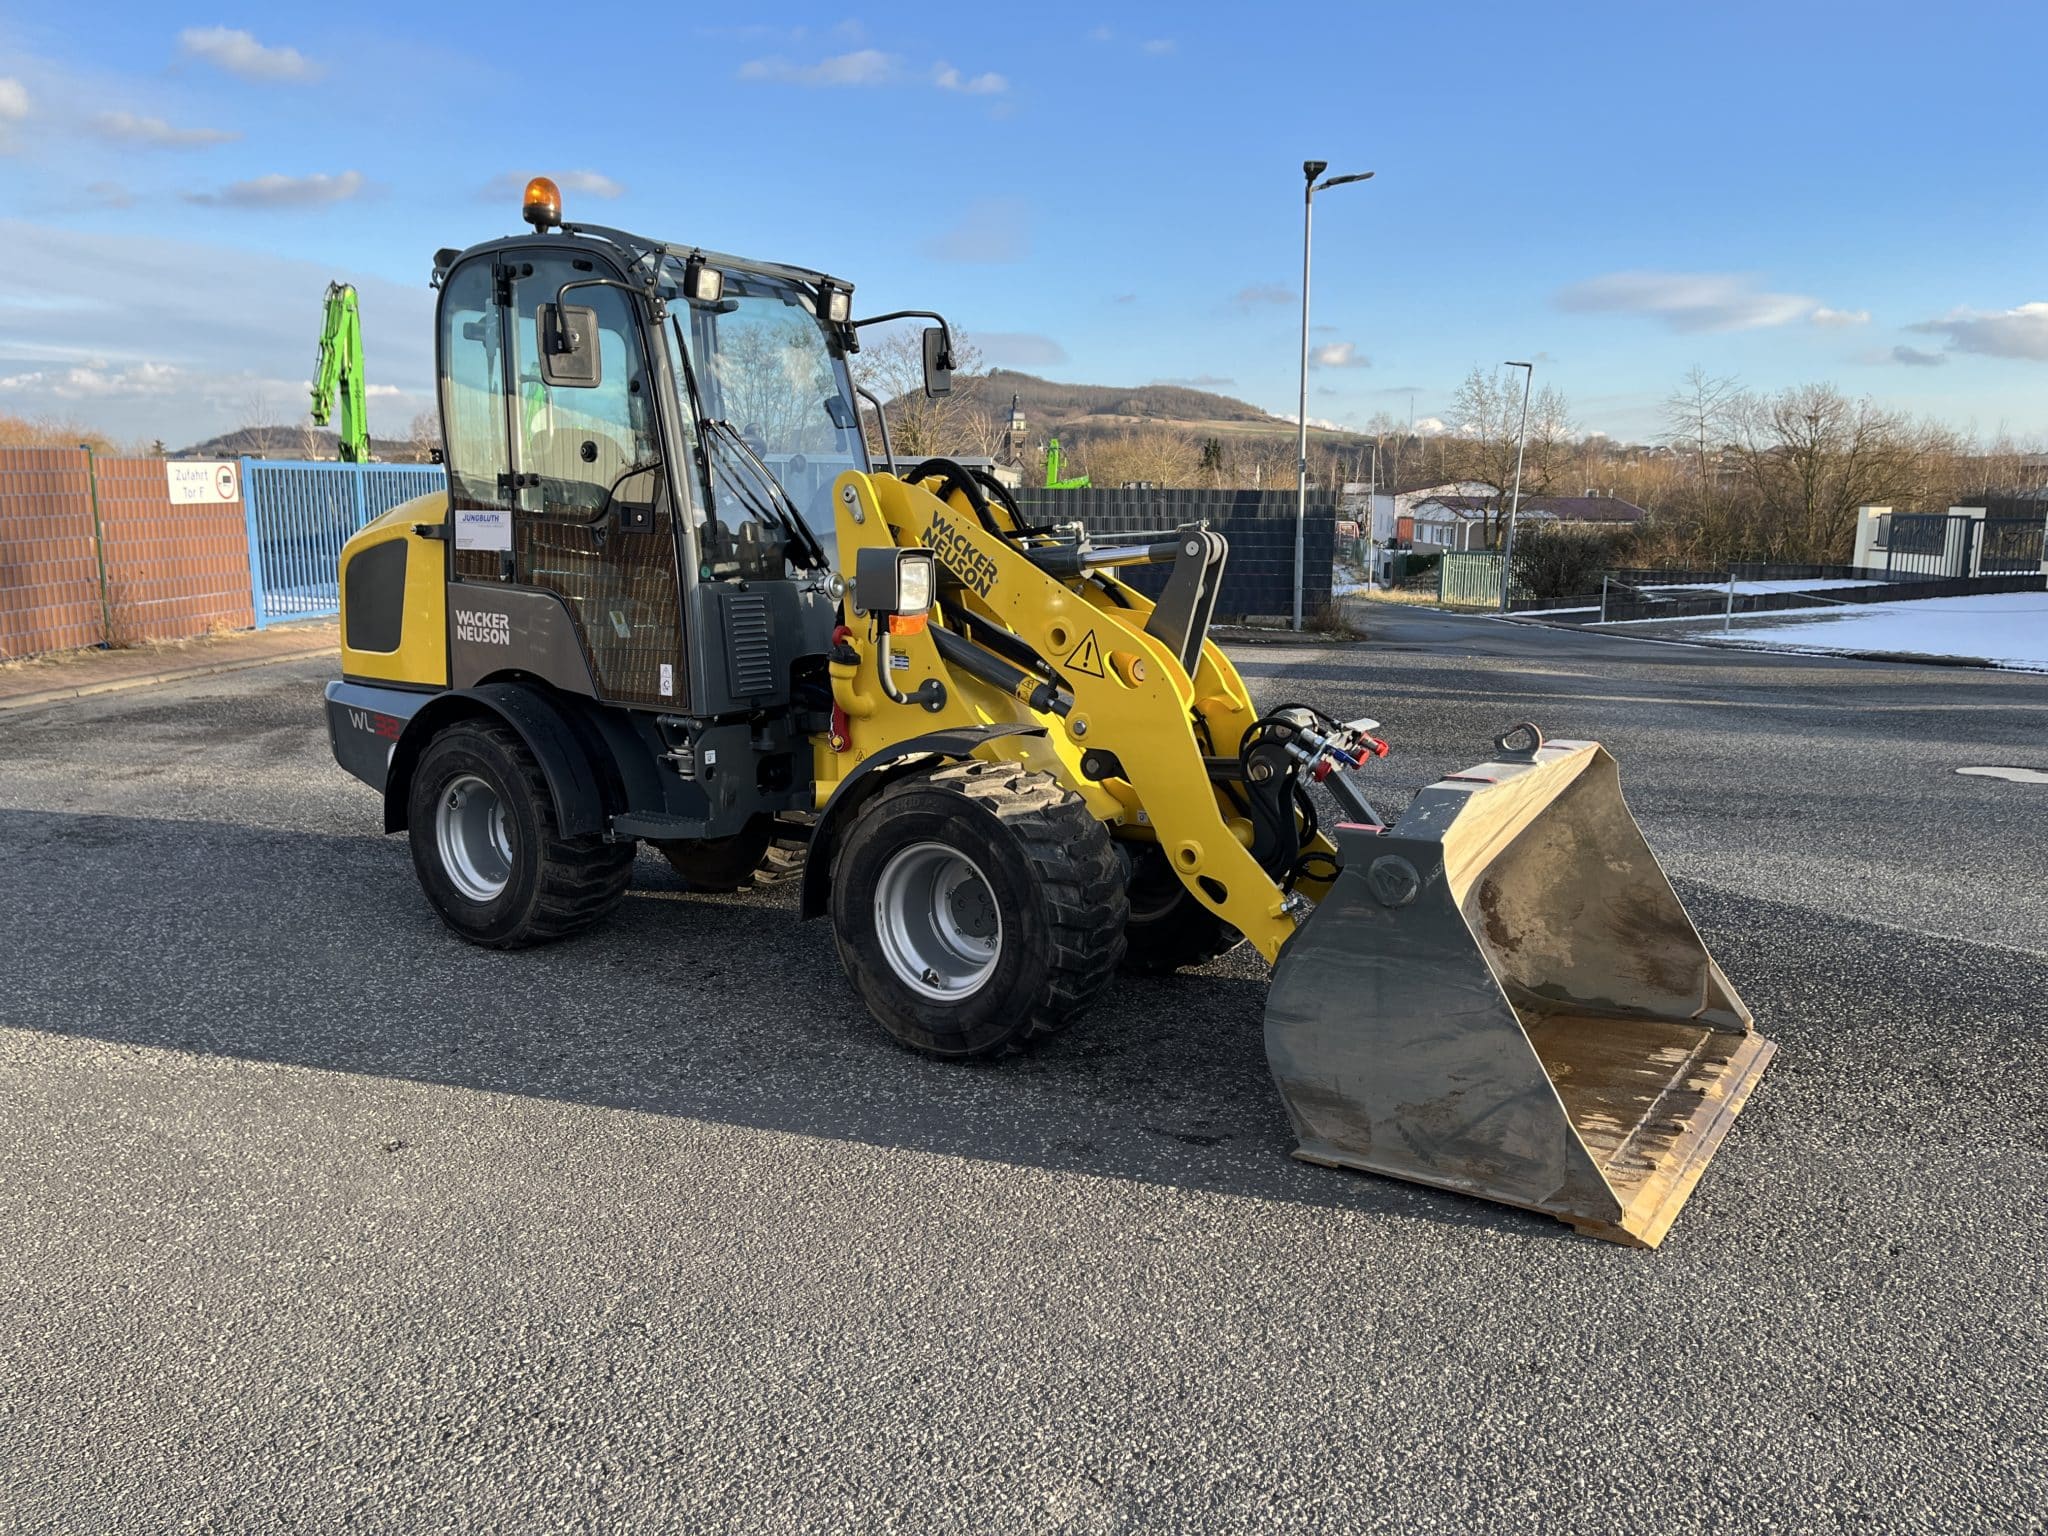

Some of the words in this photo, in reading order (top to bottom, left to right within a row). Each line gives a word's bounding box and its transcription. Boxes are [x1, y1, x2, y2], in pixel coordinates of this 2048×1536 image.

[175, 468, 209, 481] Zufahrt
[183, 487, 196, 498] Tor
[462, 513, 500, 522] JUNGBLUTH
[932, 510, 998, 584] WACKER
[921, 526, 992, 599] NEUSON
[455, 609, 510, 630] WACKER
[456, 624, 510, 646] NEUSON
